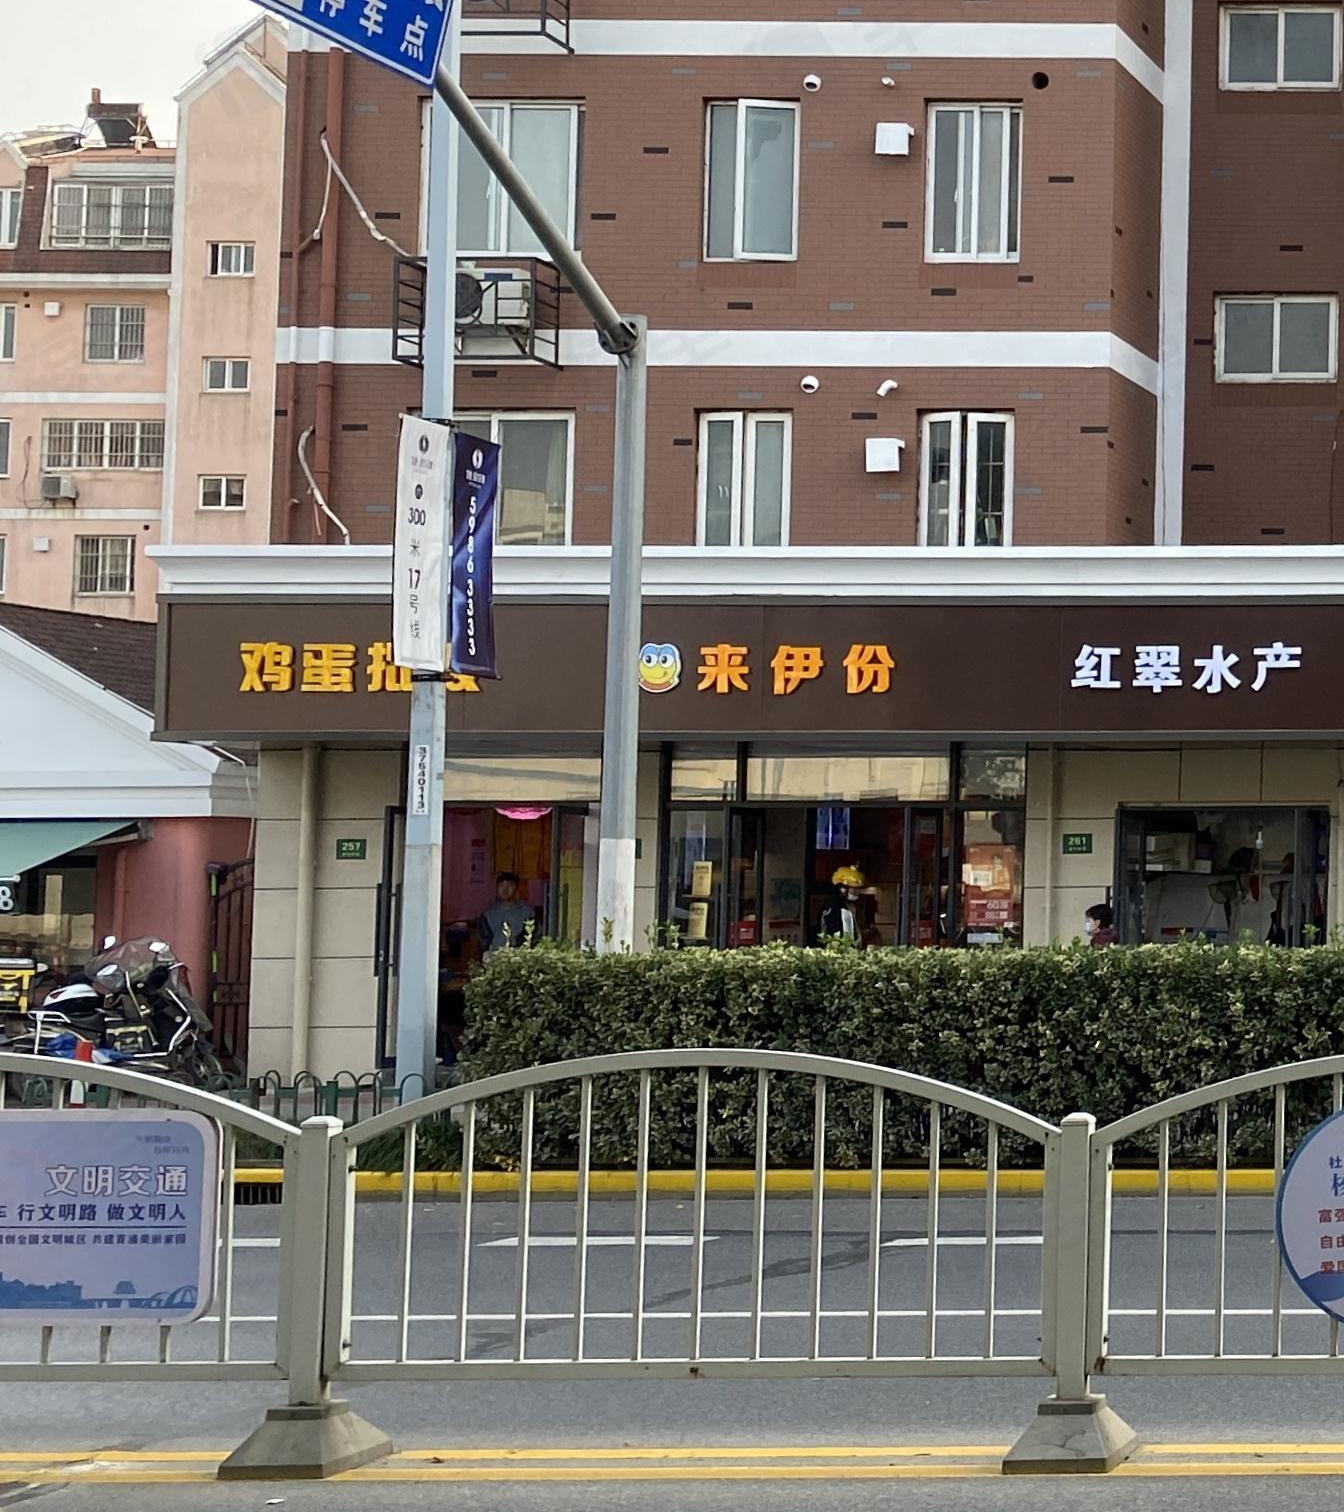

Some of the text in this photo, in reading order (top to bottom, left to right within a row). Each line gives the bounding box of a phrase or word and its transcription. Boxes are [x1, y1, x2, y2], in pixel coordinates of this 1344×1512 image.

[240, 642, 479, 692] 鸡蛋批
[698, 644, 895, 695] 来伊份
[1071, 642, 1302, 693] 红翠水产
[45, 1164, 188, 1197] 文明交通
[18, 1204, 97, 1222] 行文明路
[107, 1204, 186, 1222] 做文明人
